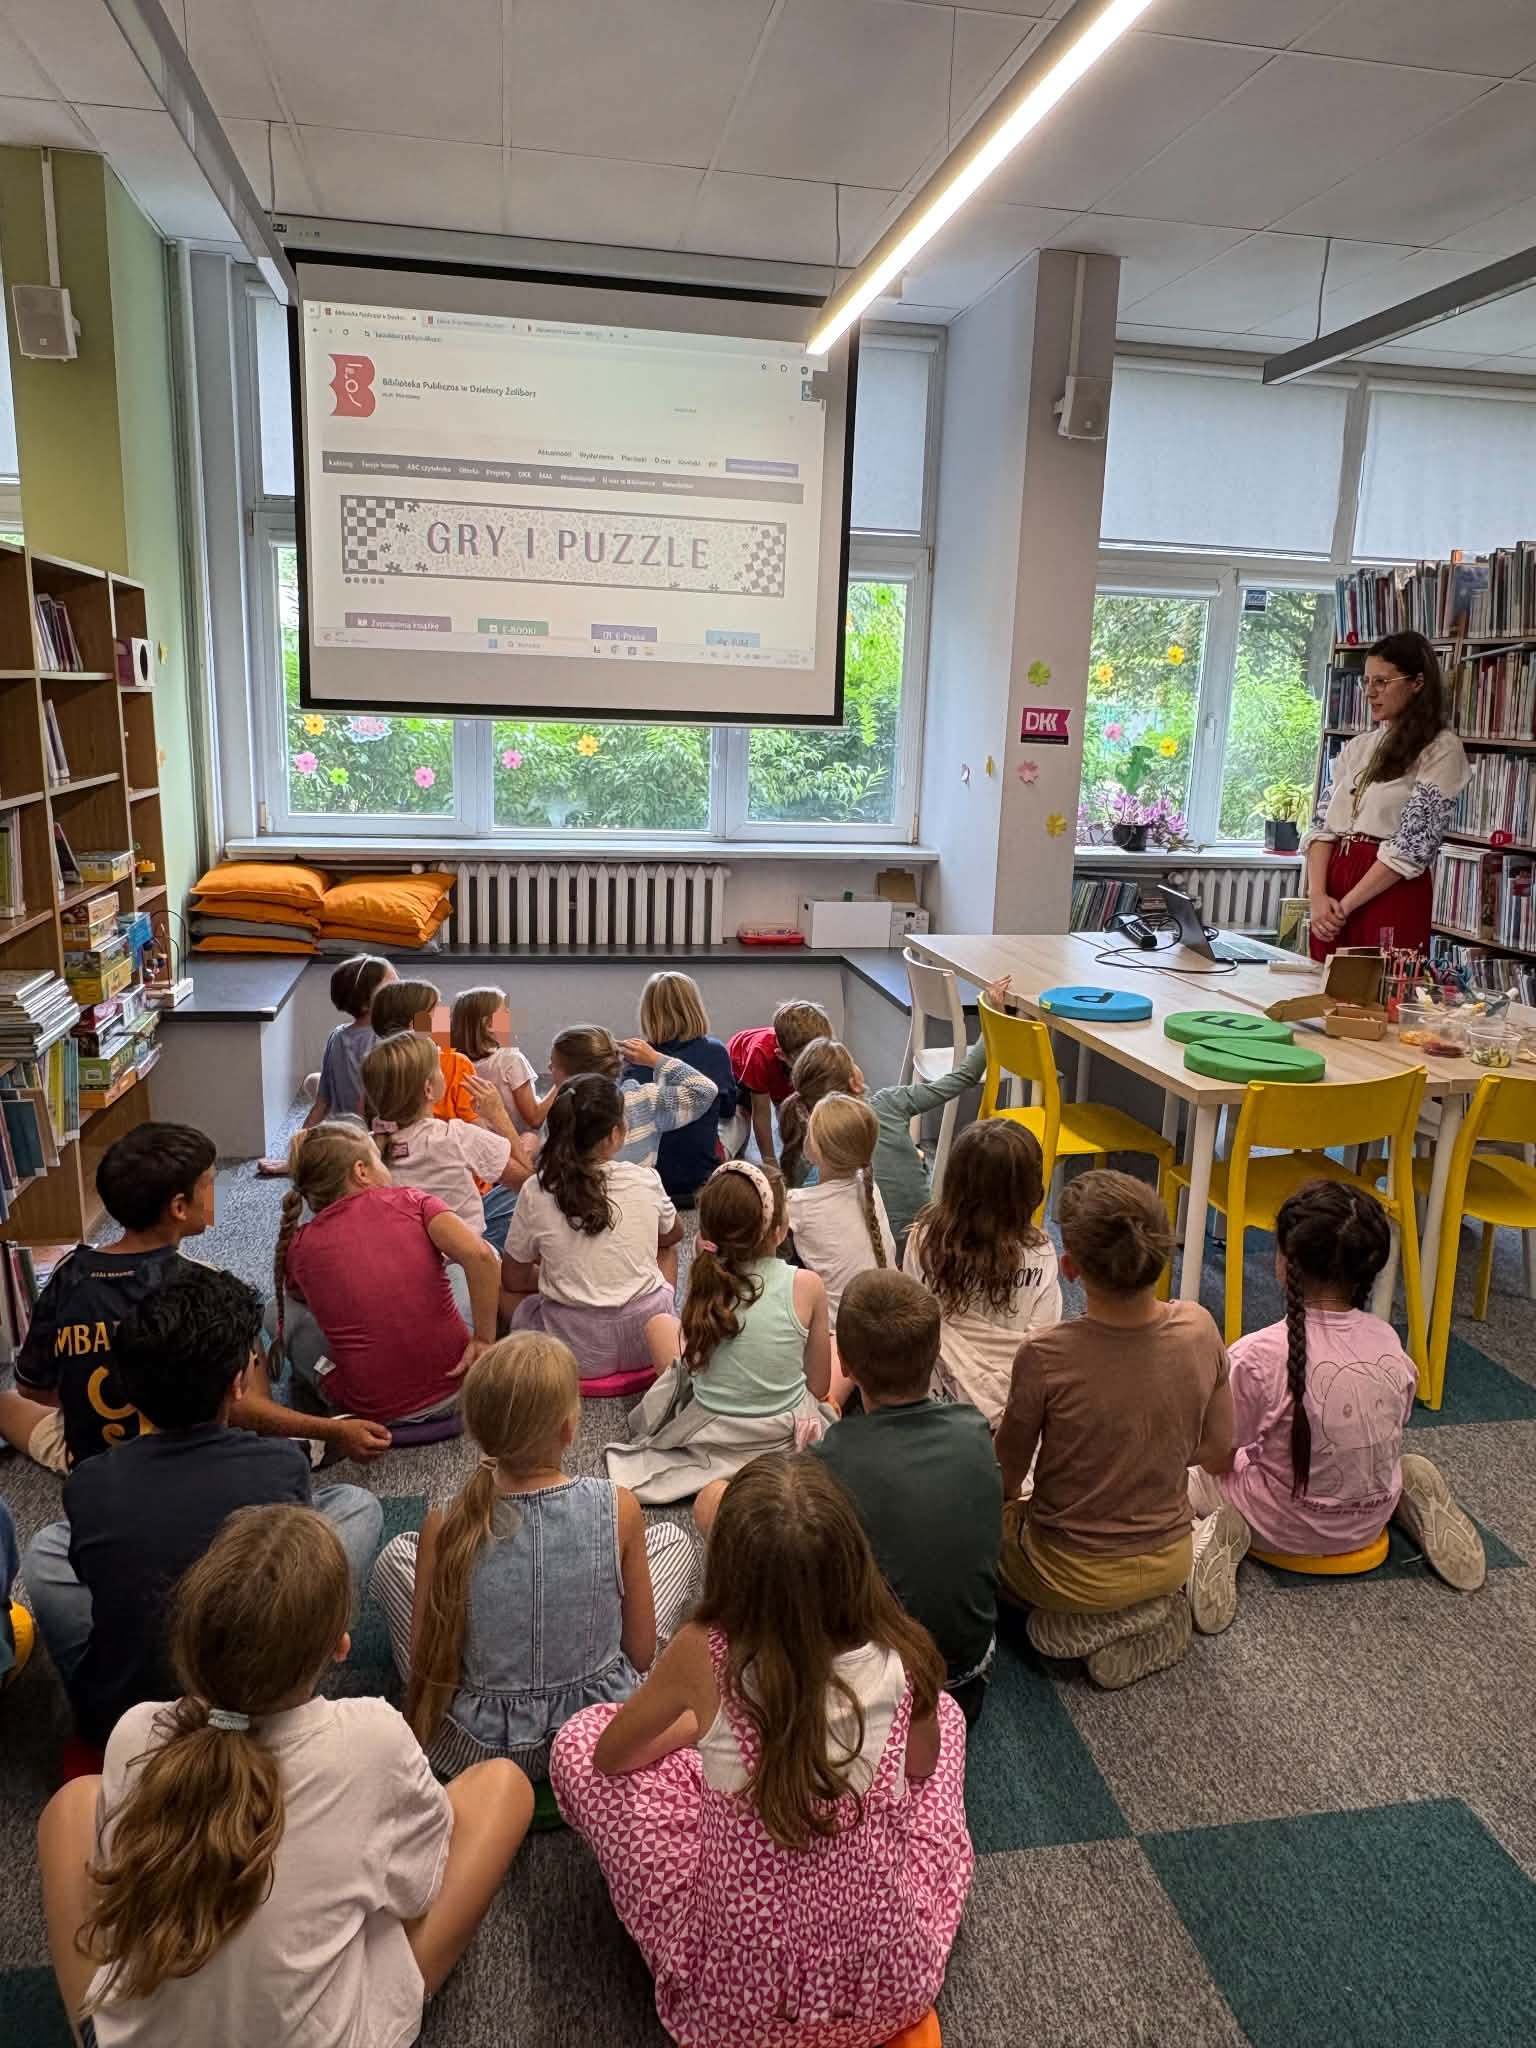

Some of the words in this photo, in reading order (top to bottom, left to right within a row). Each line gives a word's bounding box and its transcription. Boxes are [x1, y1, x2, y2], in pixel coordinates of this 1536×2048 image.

[382, 377, 421, 389] Biblioteka
[422, 381, 459, 392] Publiczna
[469, 384, 504, 397] Dzielnicy
[426, 521, 506, 557] GRY
[526, 526, 535, 560] I
[558, 529, 710, 570] PUZZLE
[54, 1320, 121, 1358] MBA
